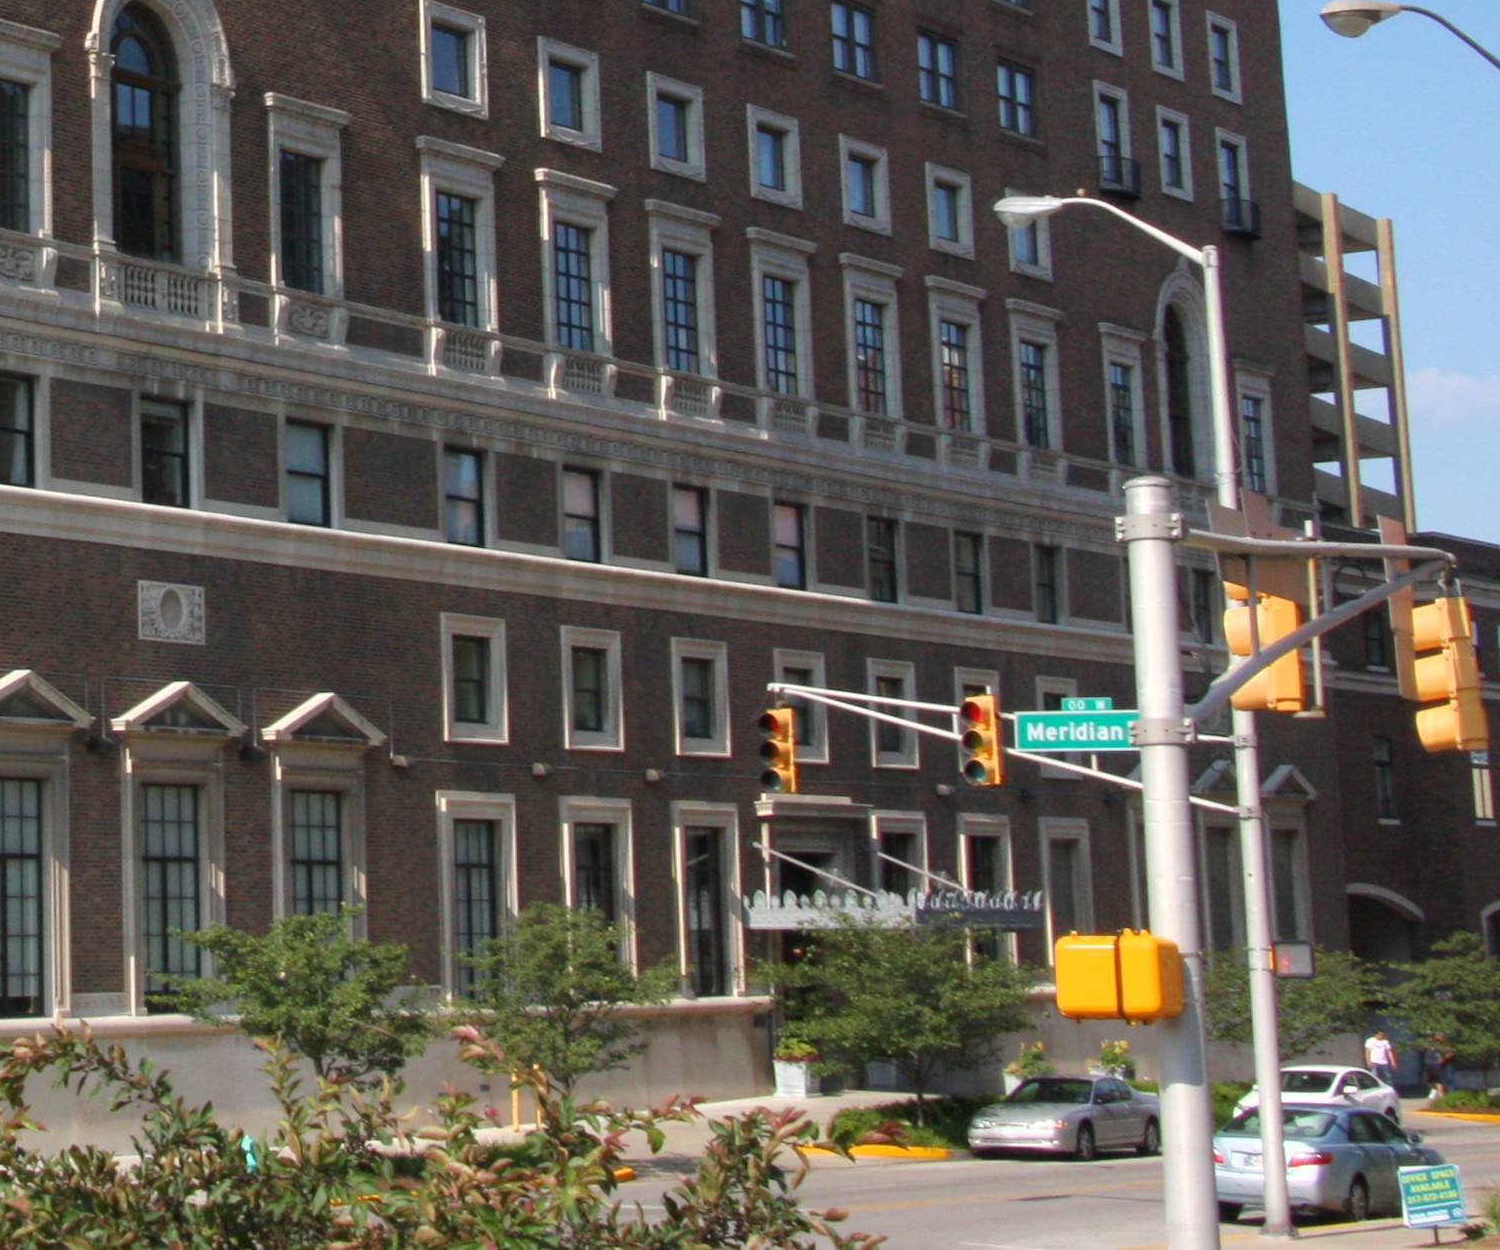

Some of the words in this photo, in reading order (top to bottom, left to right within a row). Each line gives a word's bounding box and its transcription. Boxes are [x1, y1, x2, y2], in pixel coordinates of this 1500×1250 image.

[1027, 722, 1124, 741] Meridian
[1402, 1173, 1427, 1183] OFFICE
[1411, 1180, 1450, 1192] AVAILABLE
